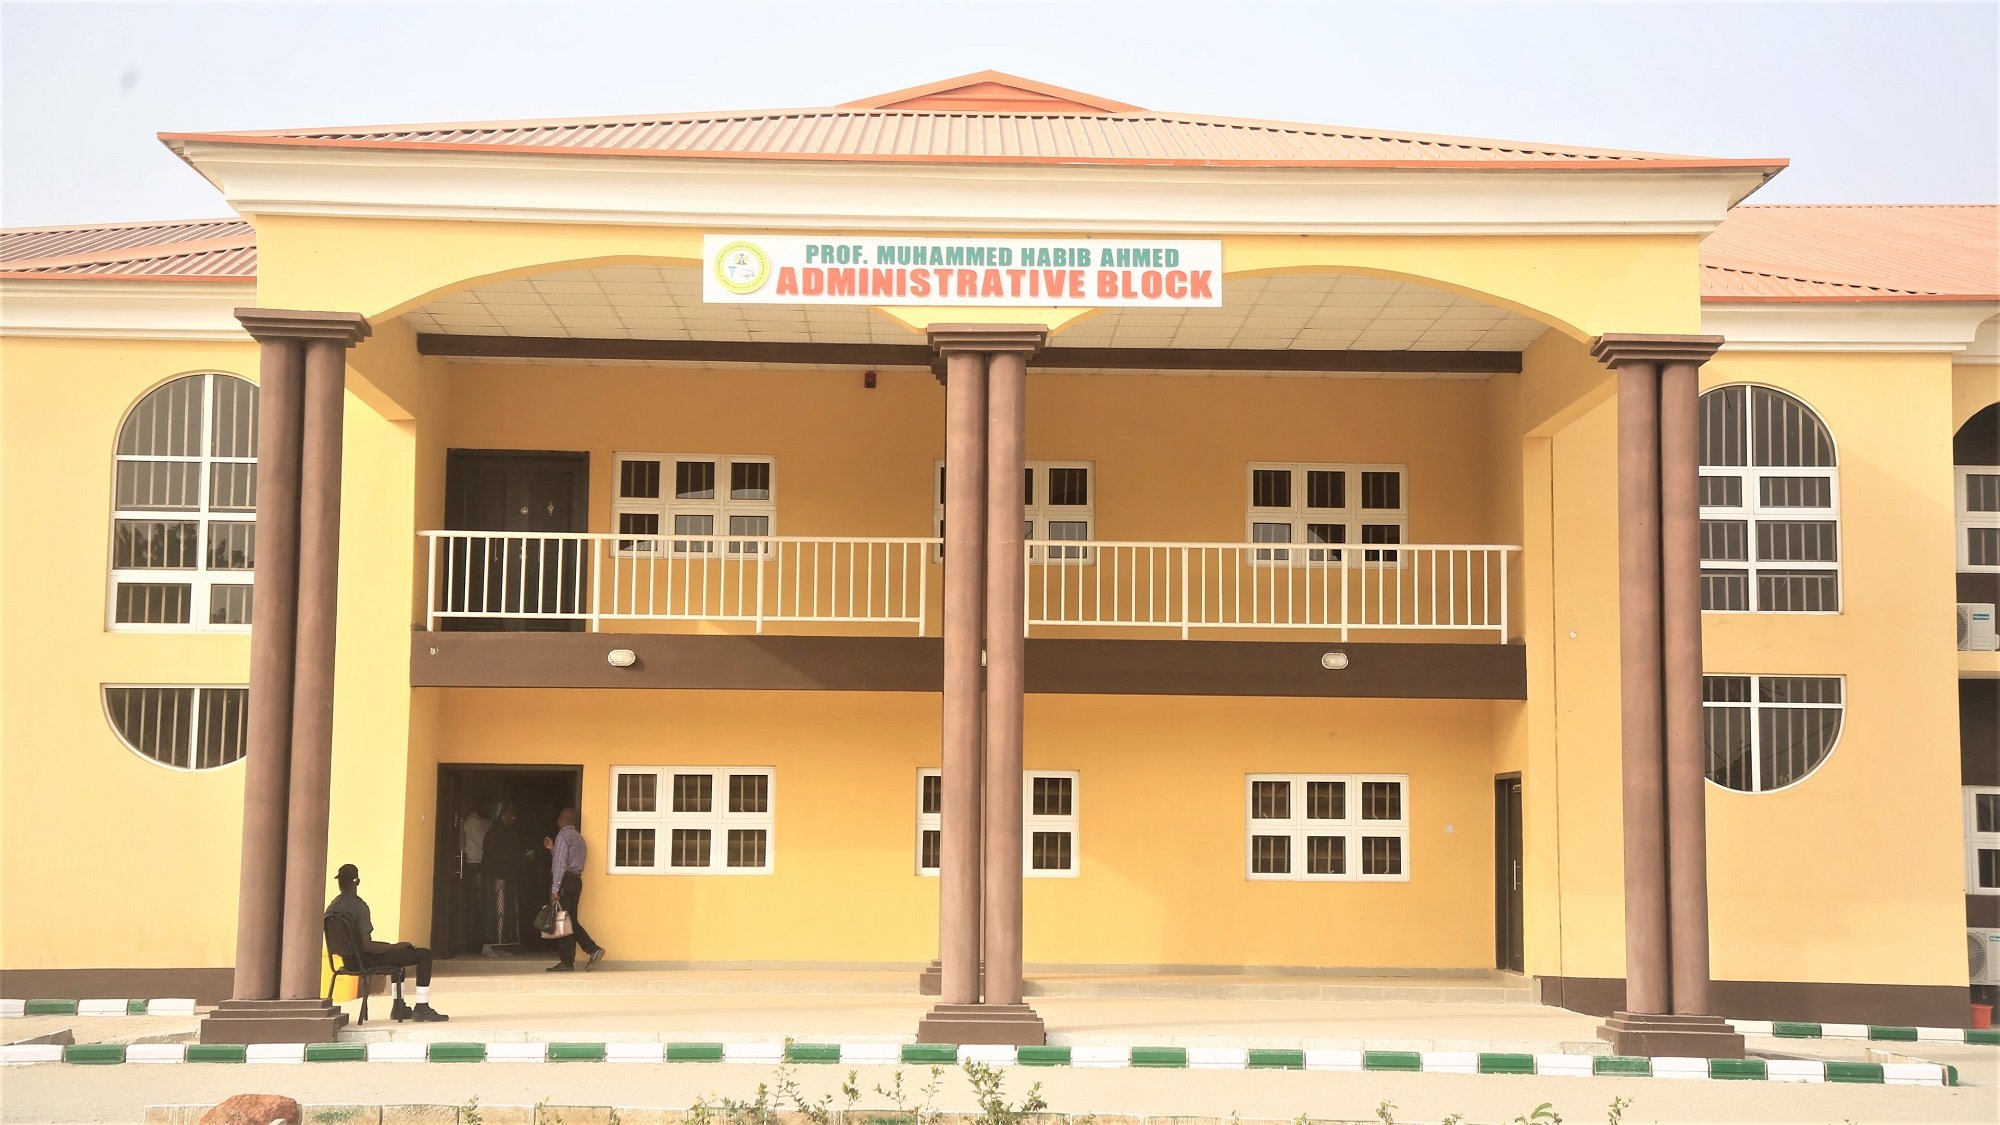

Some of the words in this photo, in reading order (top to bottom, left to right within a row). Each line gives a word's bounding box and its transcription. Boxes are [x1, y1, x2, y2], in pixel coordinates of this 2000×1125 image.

[806, 245, 868, 264] PROF.
[877, 246, 1013, 266] MUHAMMED
[1021, 248, 1091, 267] HABIB
[1100, 248, 1179, 267] AHMED
[776, 267, 1086, 298] ADMINISTRATIVE
[1097, 270, 1212, 299] BLOCK
